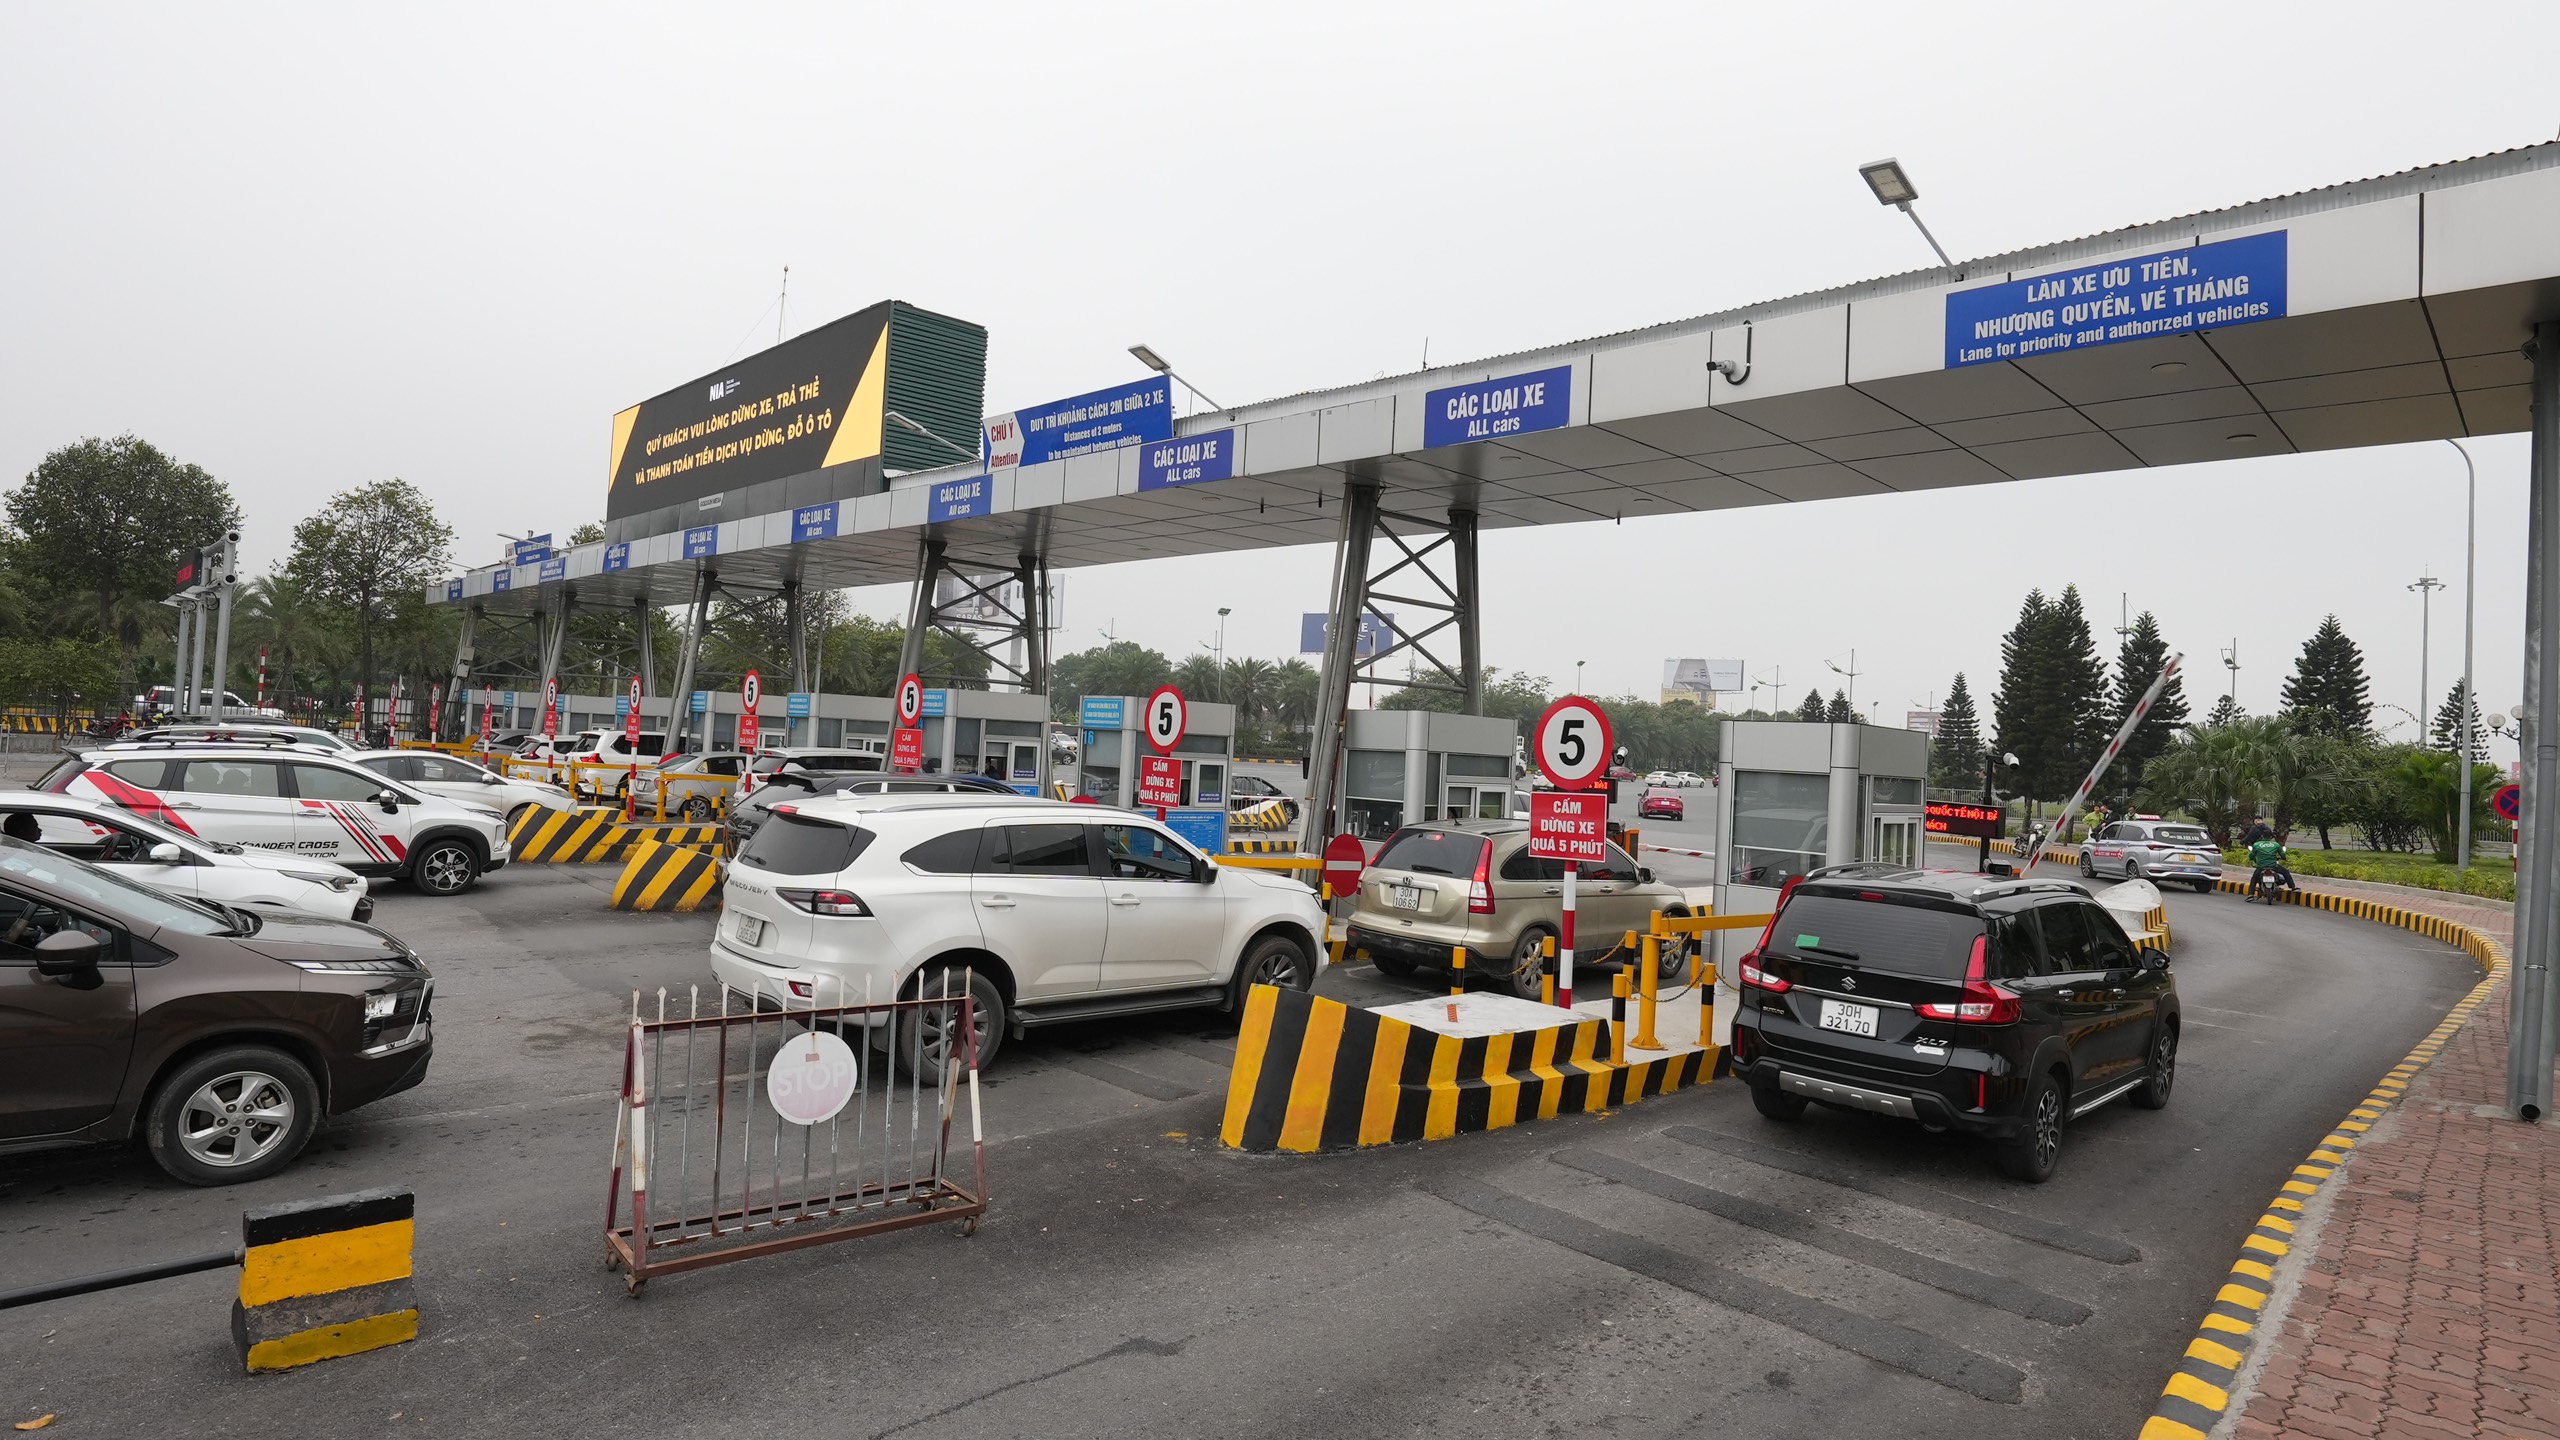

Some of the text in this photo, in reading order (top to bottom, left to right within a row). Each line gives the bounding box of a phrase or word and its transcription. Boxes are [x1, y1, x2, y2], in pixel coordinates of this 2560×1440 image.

[2028, 256, 2198, 303] LÀN XE ƯU TIÊN,
[1975, 276, 2249, 339] NHƯỢNG QUYỀN, VÉ THÁNG
[1960, 346, 1992, 362] Lane
[1996, 342, 2016, 356] for
[2020, 332, 2072, 354] priority
[2077, 326, 2104, 344] and
[2198, 302, 2269, 324] vehicles
[710, 381, 724, 401] NIA
[1447, 382, 1545, 420] CÁC LOẠI XE
[646, 375, 820, 456] QUÝ KHÁCH VUI LÒNG DỪNG XE, TRẢ THẺ
[1030, 390, 1164, 432] DUY TRÌ KHOẢNG CÁCH 2M GIỮA 2 XE
[991, 418, 1014, 442] CHÚ Ý
[1064, 423, 1122, 442] Distances of 2 meters
[1468, 416, 1520, 438] ALL cars
[636, 468, 645, 485] VÀ
[646, 462, 671, 482] THANH
[672, 453, 694, 474] TOÁN
[695, 446, 714, 467] TIỀN
[716, 442, 738, 463] DỊCH
[740, 437, 752, 456] VỤ
[806, 414, 814, 434] Ô
[817, 408, 832, 431] TÔ
[1048, 434, 1142, 460] to be maintained between vehicles
[1154, 440, 1217, 468] CÁC LOẠI XE
[991, 452, 1018, 468] Attention
[1166, 467, 1200, 482] ALL cars
[940, 482, 980, 502] CÁC LOẠI XE
[800, 508, 831, 525] CÁC LOẠI XE
[949, 504, 970, 516] All cars
[813, 526, 822, 536] cars
[633, 685, 638, 704] 5
[748, 681, 754, 702] 5
[906, 686, 914, 712] 5
[1158, 702, 1173, 736] 5
[1084, 730, 1094, 745] 16
[1559, 720, 1586, 766] 5
[1153, 758, 1168, 772] CẤM
[1165, 778, 1174, 788] XE
[1140, 788, 1178, 804] QUÁ 5 PHÚT
[1553, 798, 1582, 814] CẤM
[1930, 804, 1954, 816] QUỐC
[1954, 806, 1967, 818] TẾ
[1968, 808, 1985, 820] NỘI
[1541, 816, 1595, 834] DỪNG XE
[298, 841, 339, 849] CROSS
[1532, 836, 1603, 855] QUÁ 5 PHÚT
[1400, 888, 1412, 898] 30A
[1838, 1004, 1862, 1018] 30H
[1826, 1016, 1870, 1034] 321.70
[1916, 1036, 1948, 1046] XL7
[776, 1061, 848, 1096] STOP
